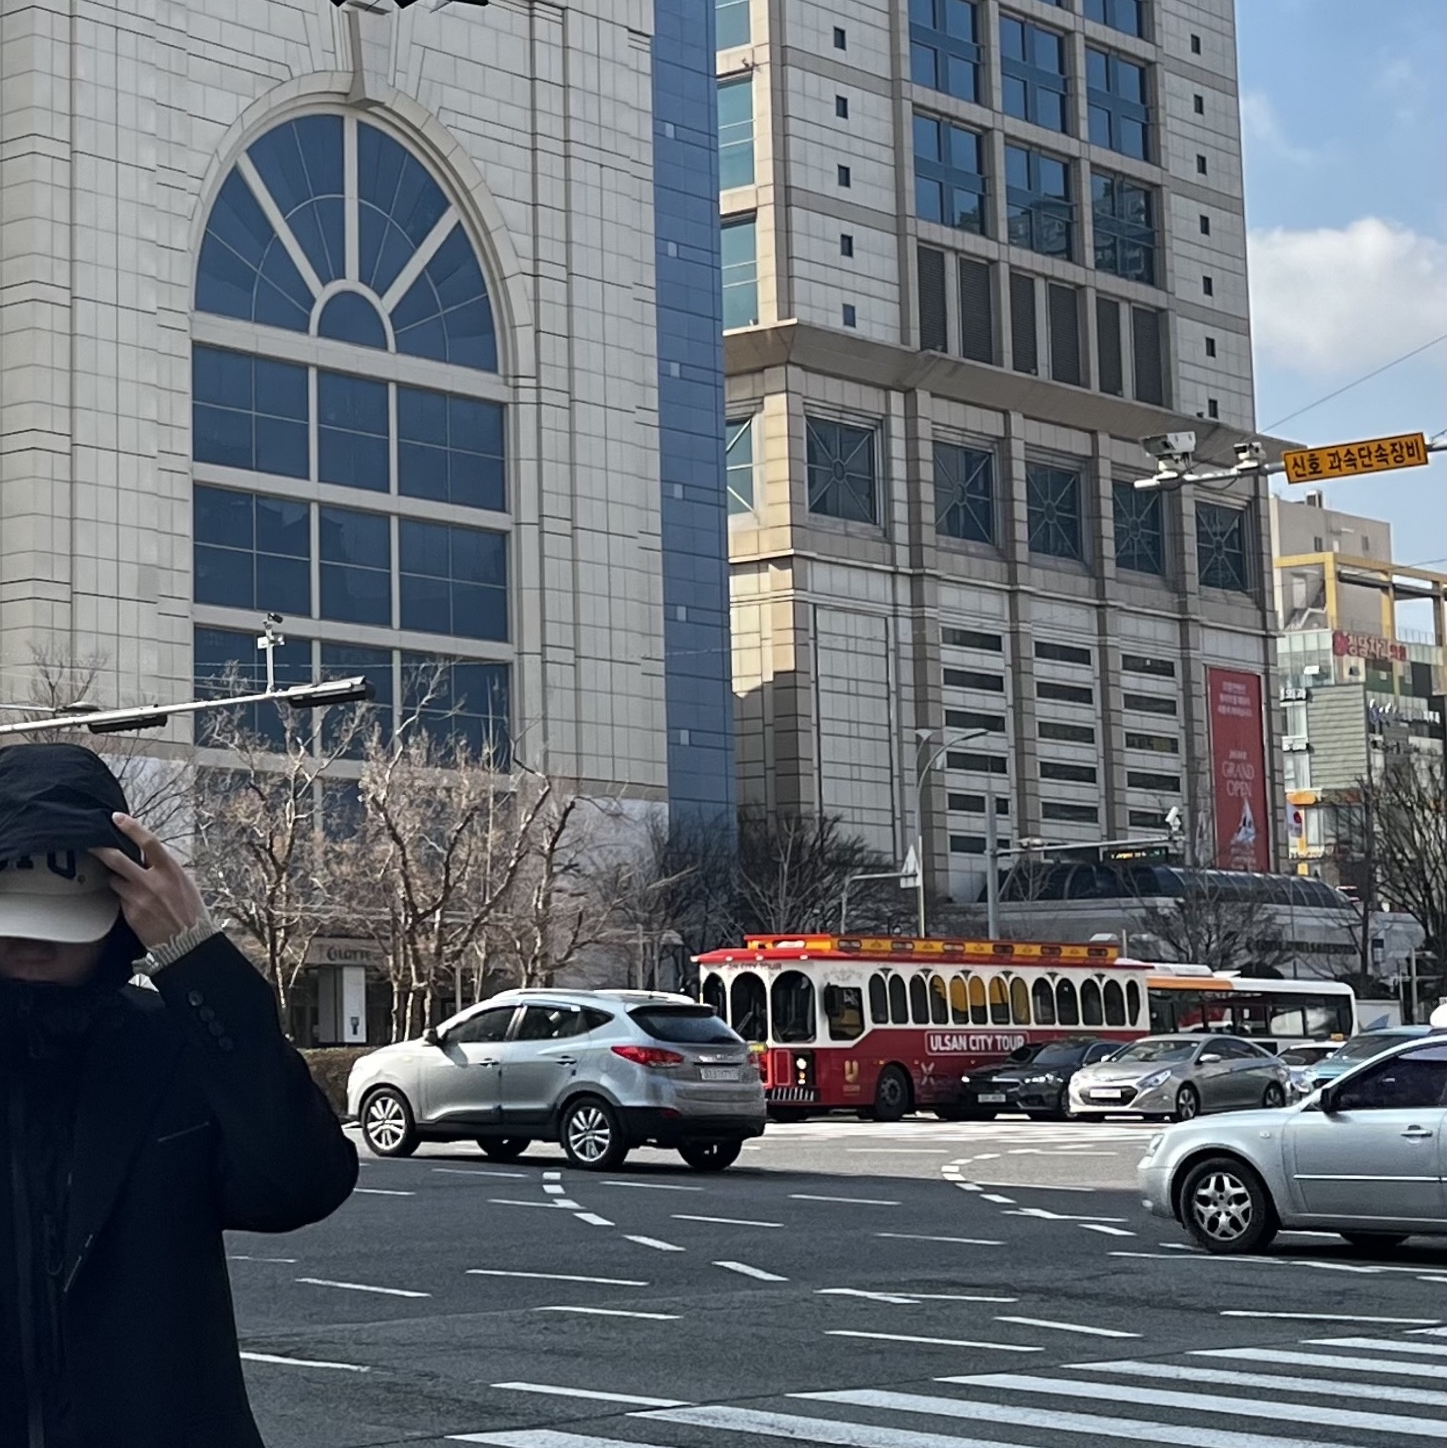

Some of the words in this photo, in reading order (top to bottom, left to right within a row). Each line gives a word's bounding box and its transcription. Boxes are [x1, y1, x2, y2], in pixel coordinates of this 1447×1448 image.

[1292, 452, 1323, 478] 신호
[1327, 438, 1422, 472] 과속단속장비
[930, 1034, 967, 1051] ULSAN
[969, 1034, 993, 1051] CITY
[995, 1034, 1025, 1051] TOUR
